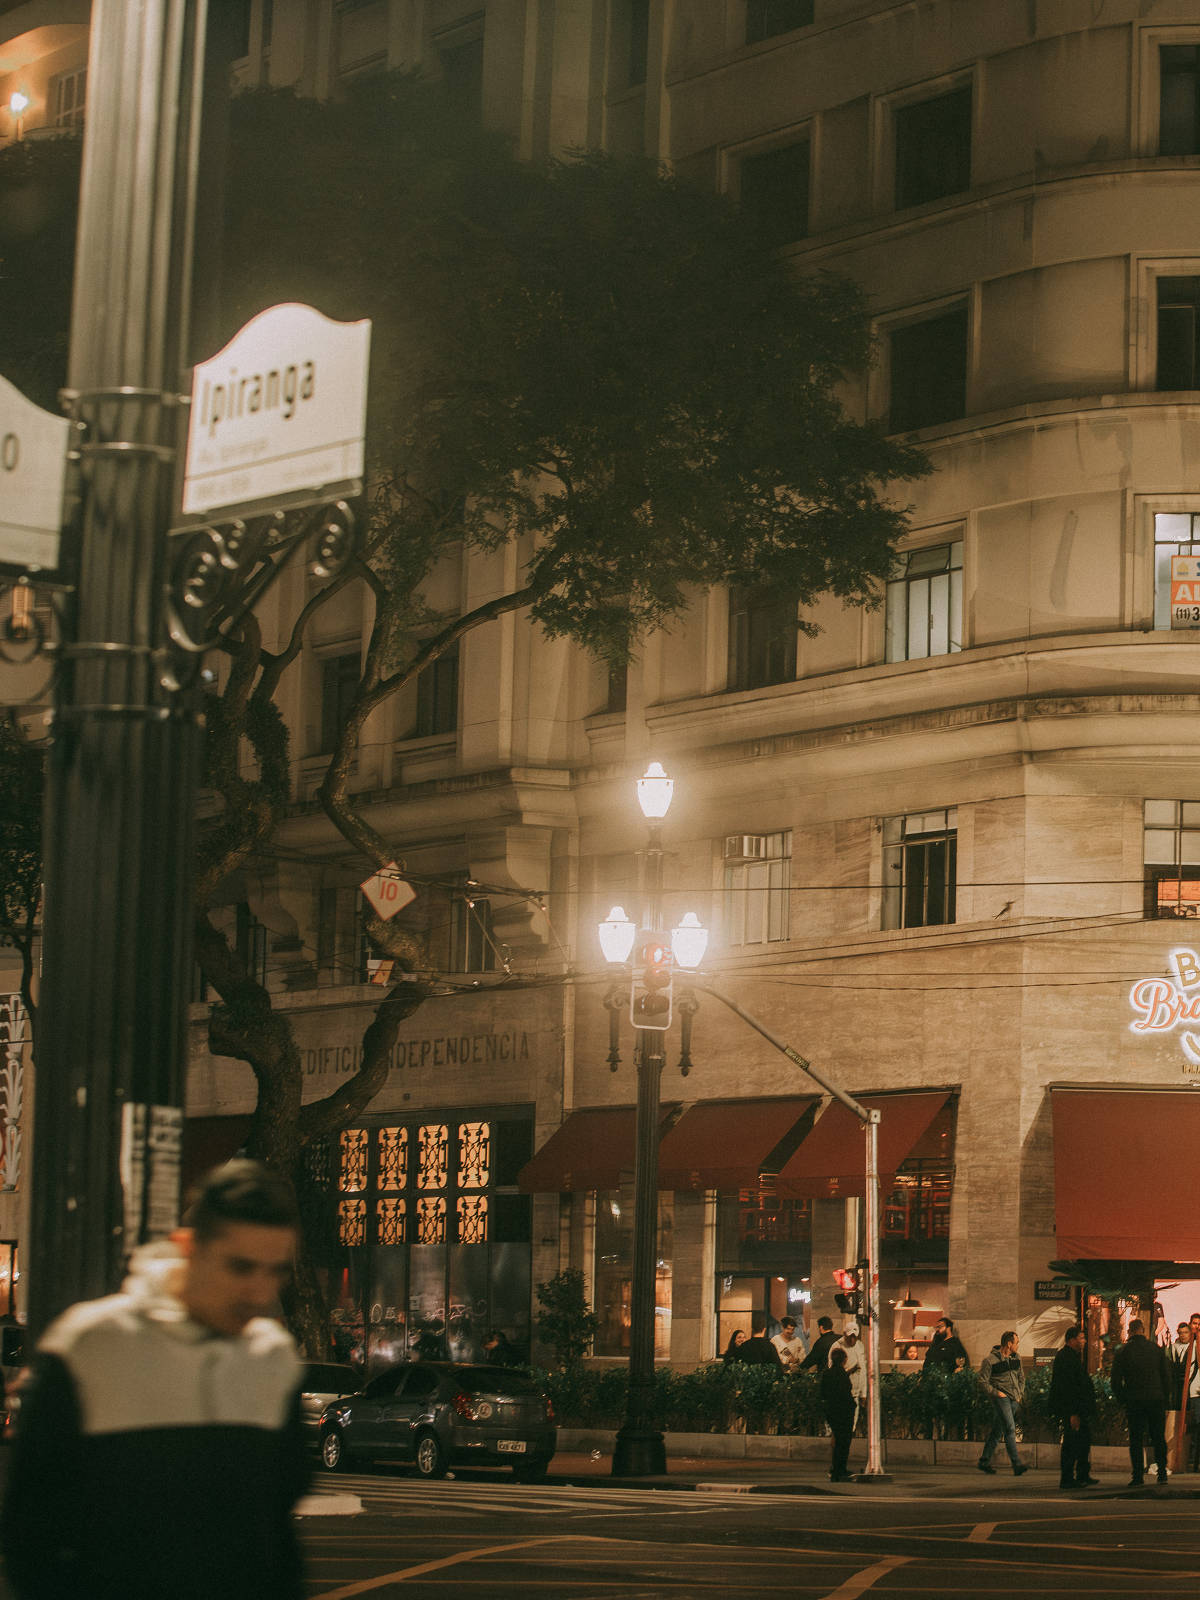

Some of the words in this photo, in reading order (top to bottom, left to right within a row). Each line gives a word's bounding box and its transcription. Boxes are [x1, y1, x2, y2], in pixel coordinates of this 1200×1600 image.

[200, 359, 315, 437] Ipiranga
[1175, 607, 1191, 621] (11)
[379, 880, 399, 902] 10
